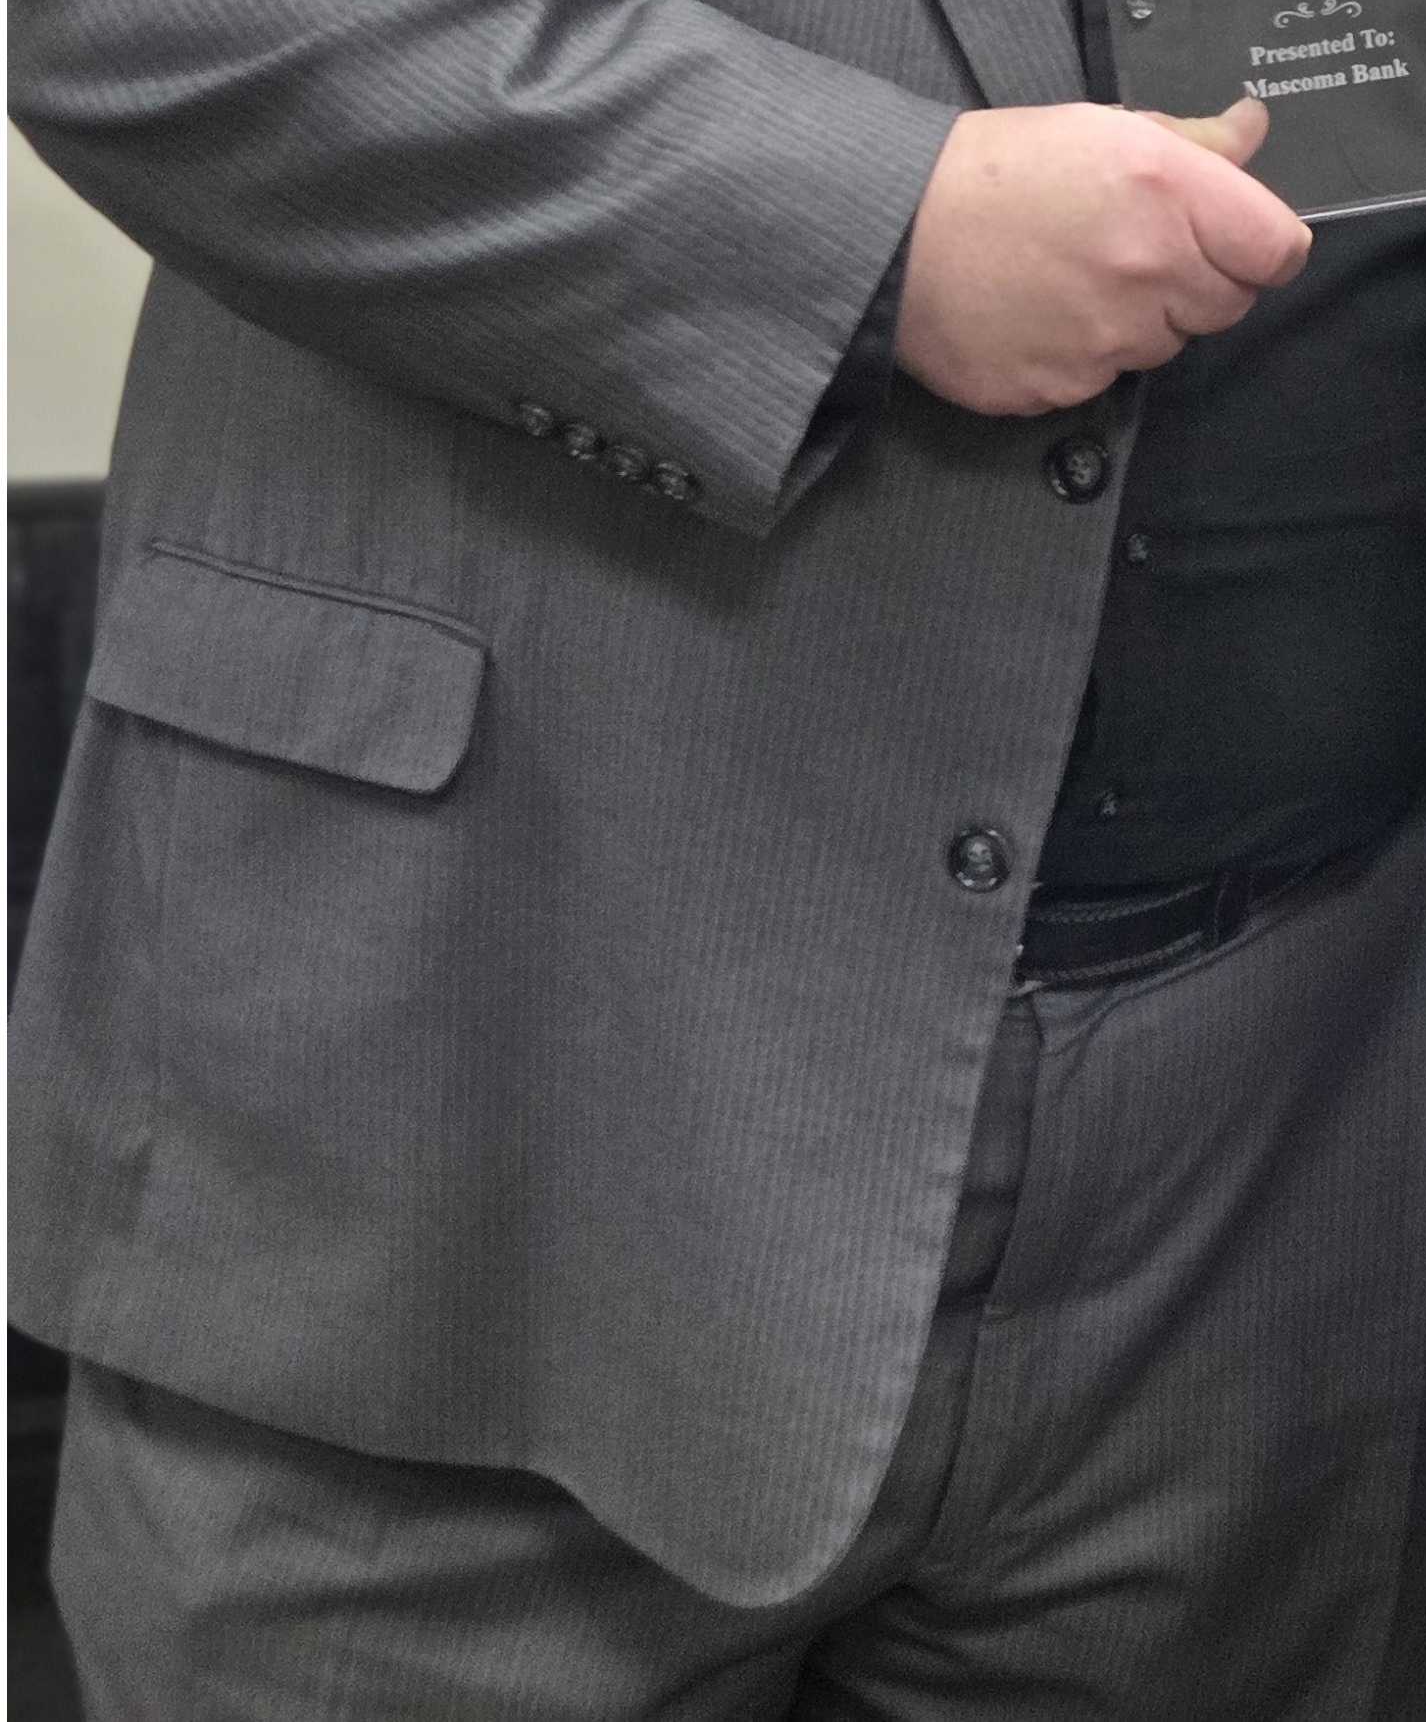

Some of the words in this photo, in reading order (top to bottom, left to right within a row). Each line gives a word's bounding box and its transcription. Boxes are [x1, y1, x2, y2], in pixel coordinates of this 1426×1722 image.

[1250, 32, 1356, 66] Presented
[1360, 28, 1395, 49] To:
[1243, 71, 1348, 98] Mascoma
[1351, 58, 1410, 84] Bank
